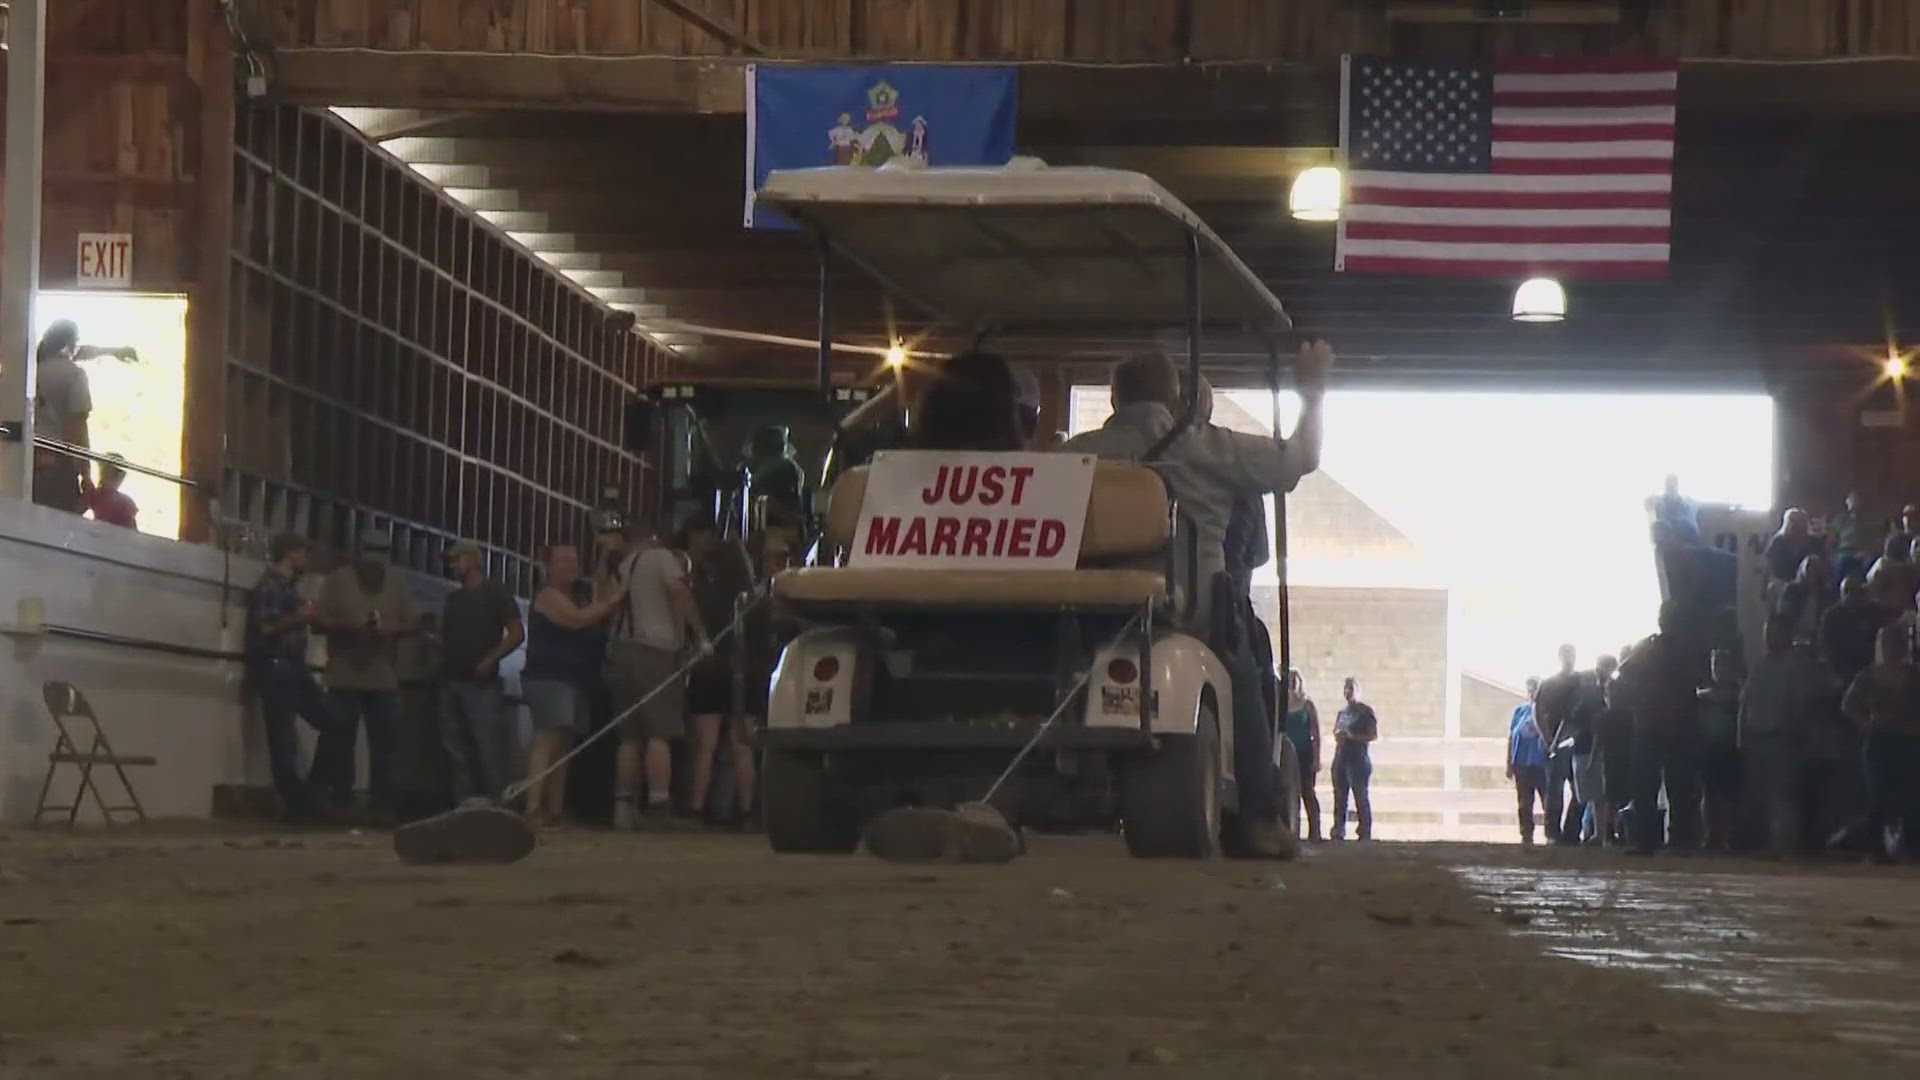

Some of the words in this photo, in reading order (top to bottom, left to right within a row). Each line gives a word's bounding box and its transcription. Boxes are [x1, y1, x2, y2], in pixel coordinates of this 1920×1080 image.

[81, 241, 129, 278] EXIT
[922, 465, 1034, 506] JUST
[865, 516, 1067, 558] MARRIED
